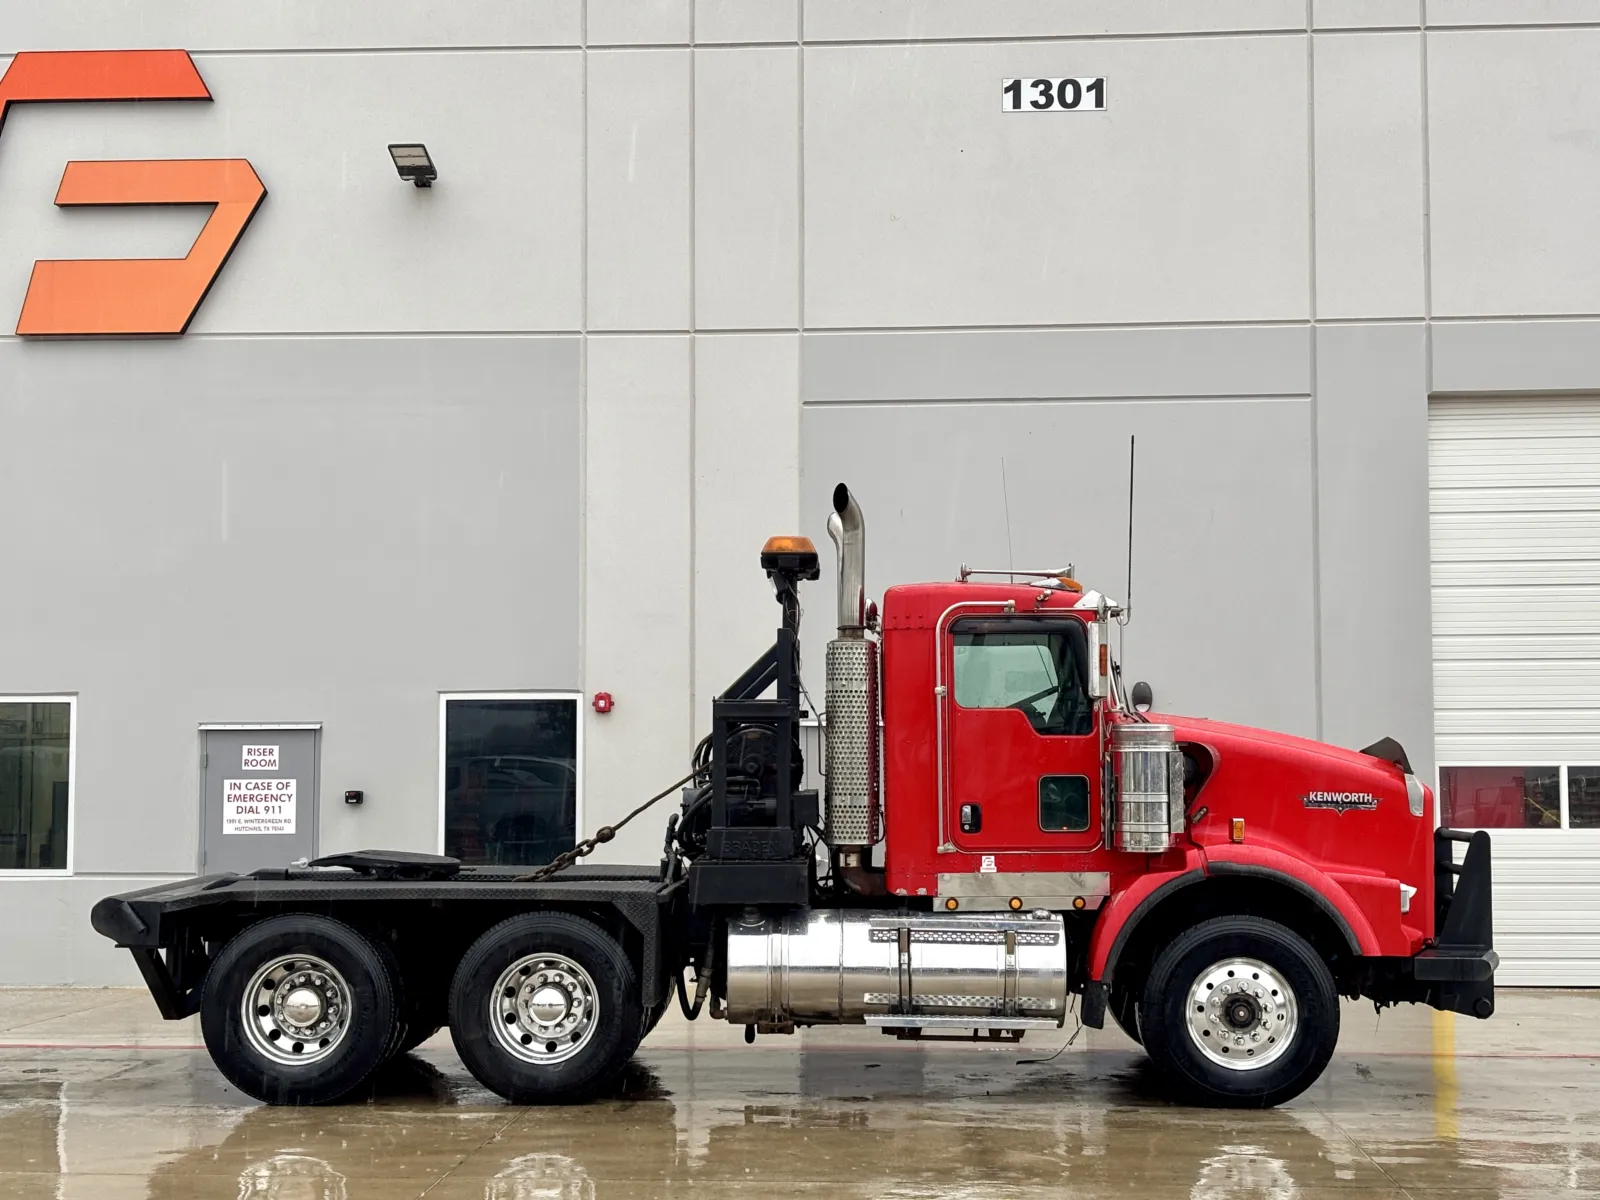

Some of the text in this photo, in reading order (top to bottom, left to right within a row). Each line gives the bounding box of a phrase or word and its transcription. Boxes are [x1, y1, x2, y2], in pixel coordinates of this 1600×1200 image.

[1003, 78, 1104, 110] 1301
[247, 748, 274, 757] RISER
[244, 759, 277, 768] ROOM
[229, 782, 291, 791] IN CASE OF
[227, 794, 293, 803] EMERGENCY
[1309, 791, 1373, 803] KENWORTH
[236, 805, 282, 814] DIAL 911
[722, 840, 778, 854] BRADEN
